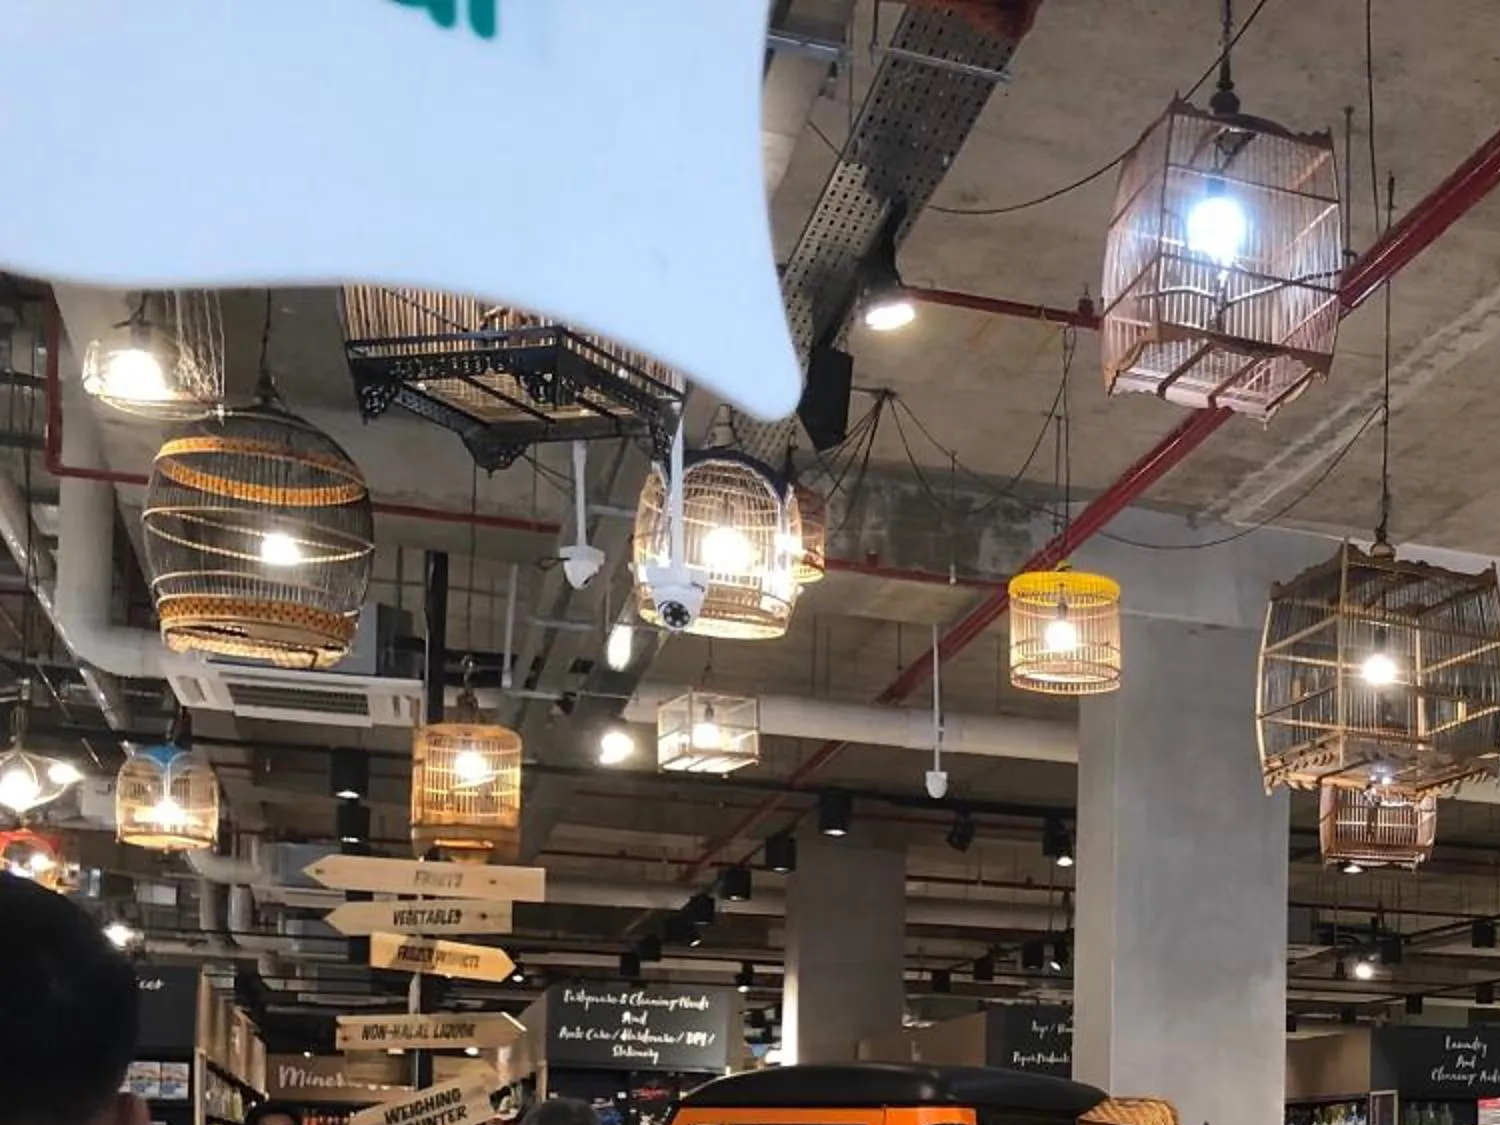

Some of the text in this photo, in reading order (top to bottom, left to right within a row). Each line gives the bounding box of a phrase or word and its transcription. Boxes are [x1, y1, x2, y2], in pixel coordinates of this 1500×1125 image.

[393, 908, 462, 926] VEGETABLES
[621, 1010, 648, 1026] And
[1445, 1036, 1487, 1058] Laundry
[1455, 1055, 1477, 1068] And
[384, 1087, 462, 1125] WEIGHING
